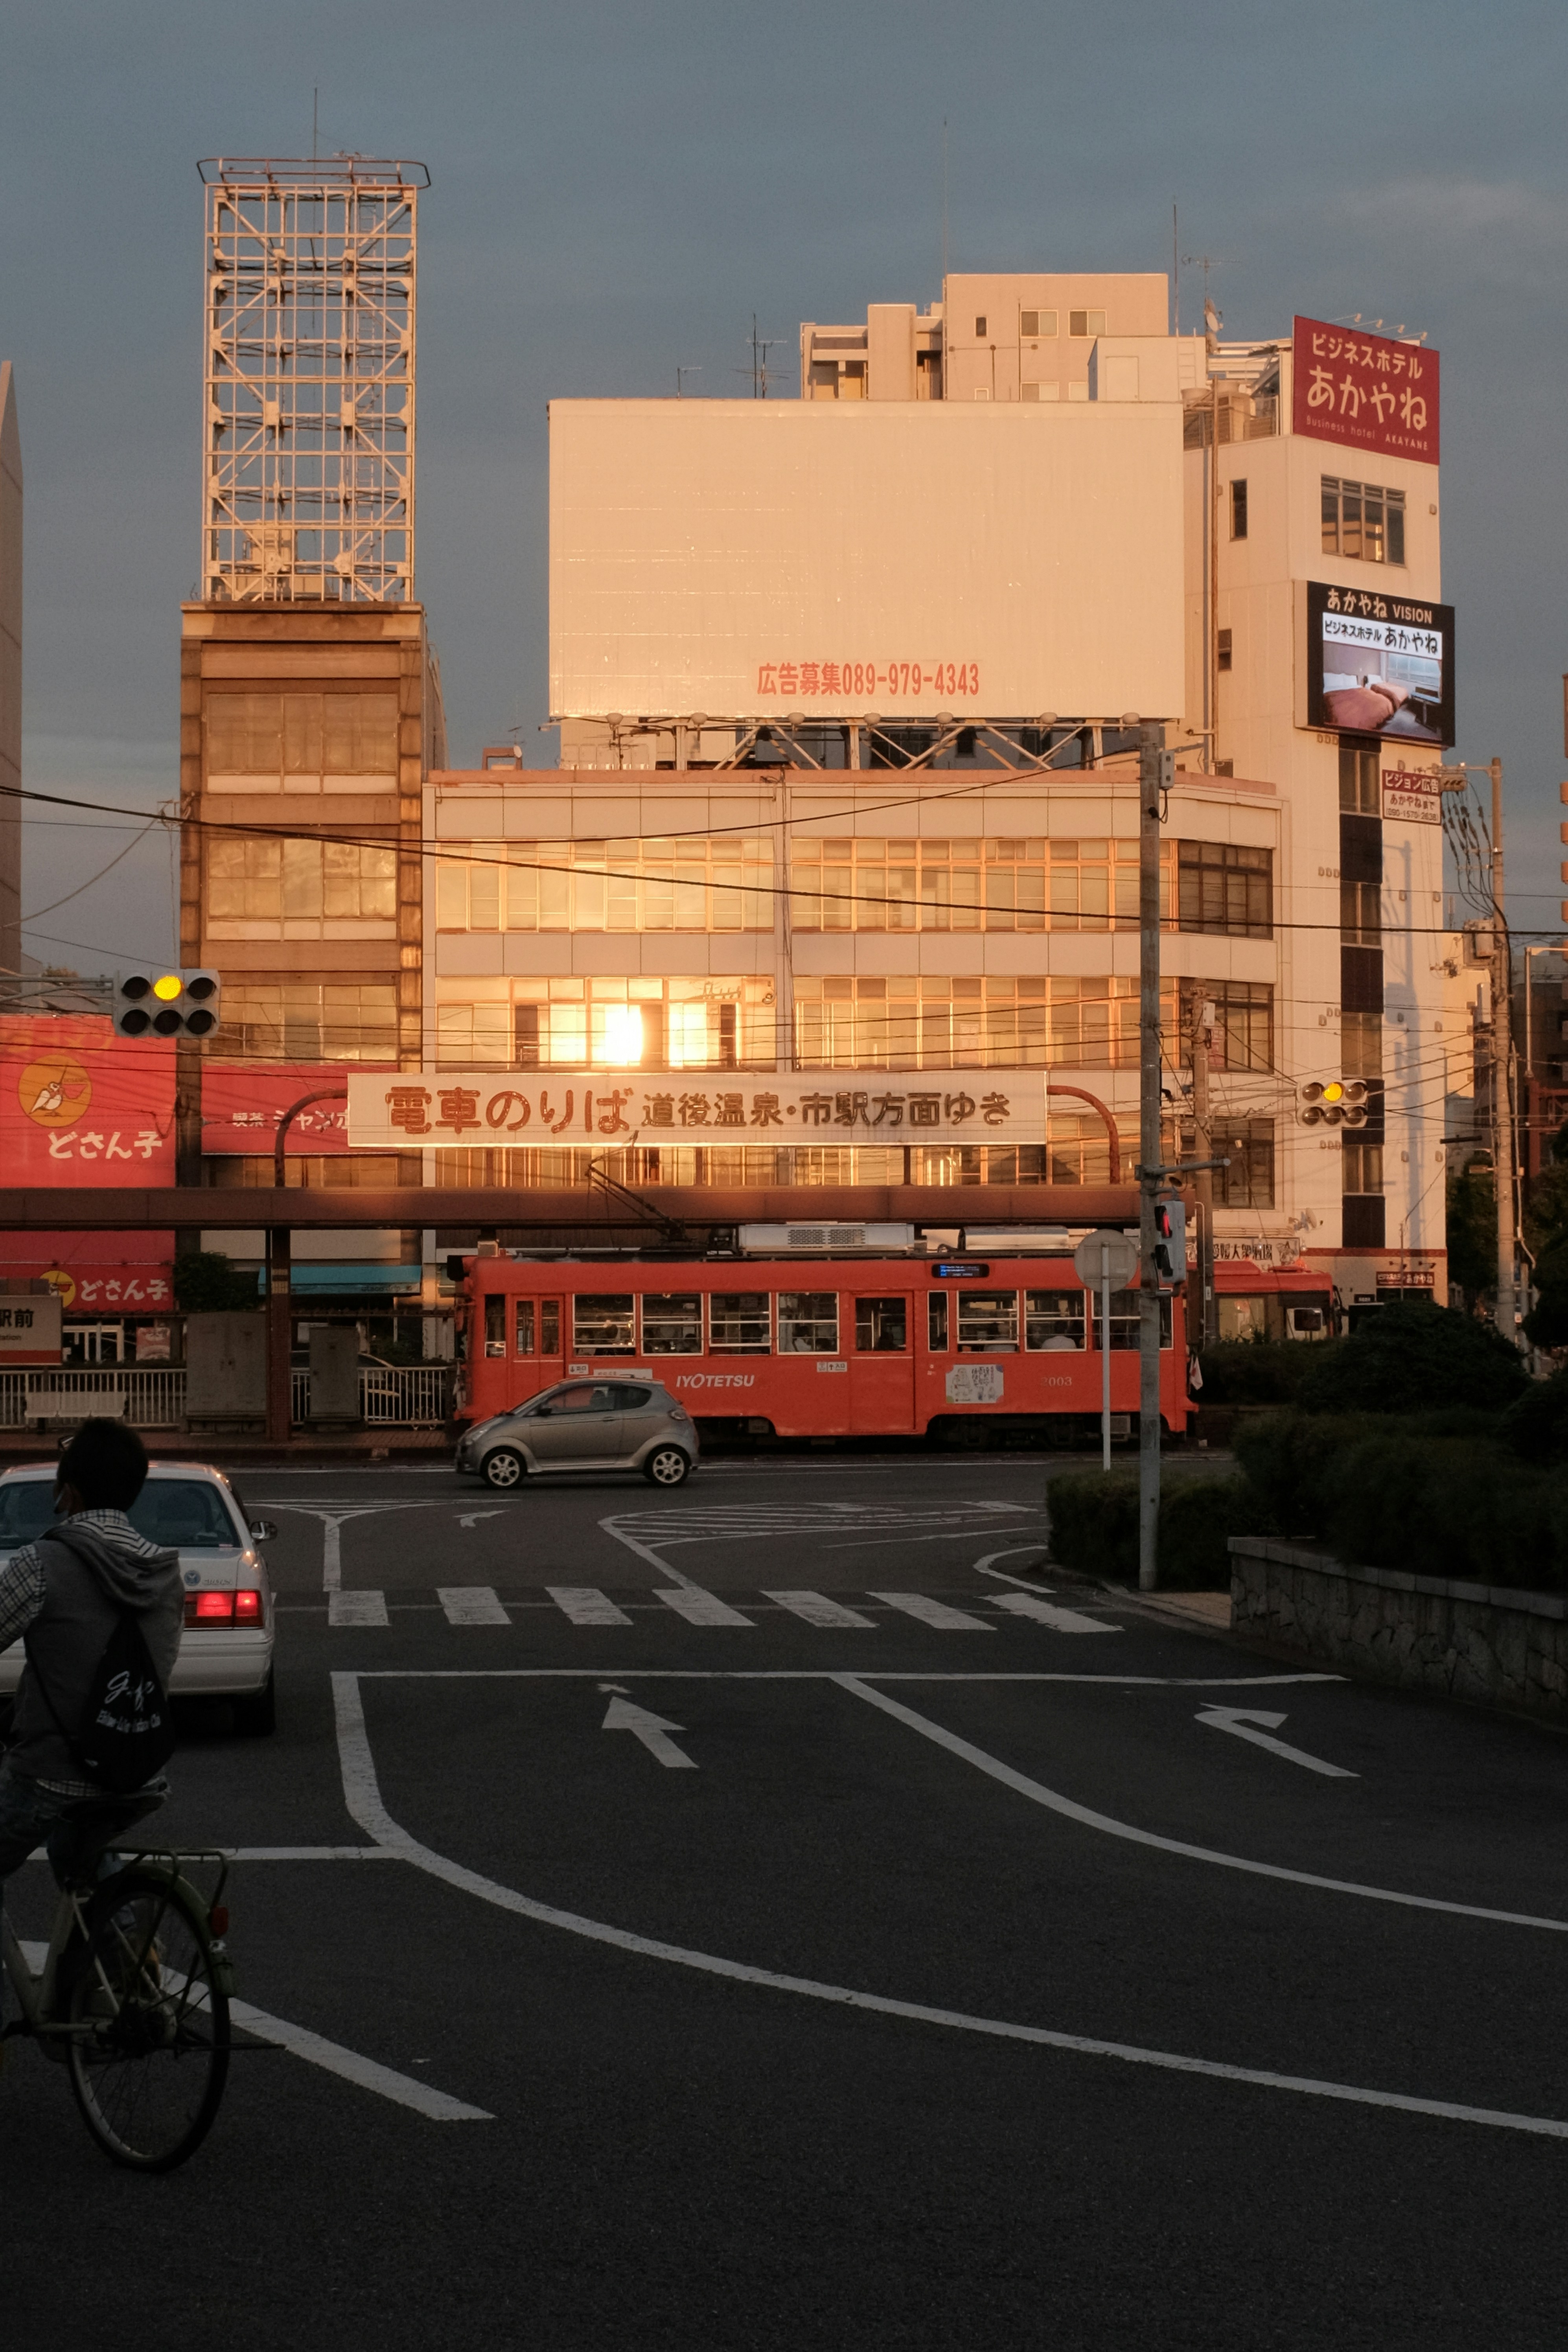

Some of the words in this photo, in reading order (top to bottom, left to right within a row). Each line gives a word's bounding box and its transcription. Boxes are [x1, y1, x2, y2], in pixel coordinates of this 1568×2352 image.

[1312, 333, 1423, 379] ビジネスホテル
[1307, 364, 1427, 431] あかやね
[1306, 415, 1345, 434] Business
[1351, 426, 1376, 440] hotel
[1385, 433, 1428, 451] AKAYANE
[1327, 588, 1388, 618] あかやね
[1392, 604, 1433, 624] VISION
[1325, 619, 1382, 642] ビジネスホテル
[1384, 626, 1438, 654] あかやね
[757, 662, 979, 696] 広告募集089-979-4343
[385, 1086, 634, 1134] 電車のりば
[642, 1092, 1010, 1127] 道後温泉・市駅方面ゆき
[48, 1131, 162, 1159] どさん子
[81, 1279, 169, 1301] どさん子
[675, 1373, 755, 1389] IYOTETSU
